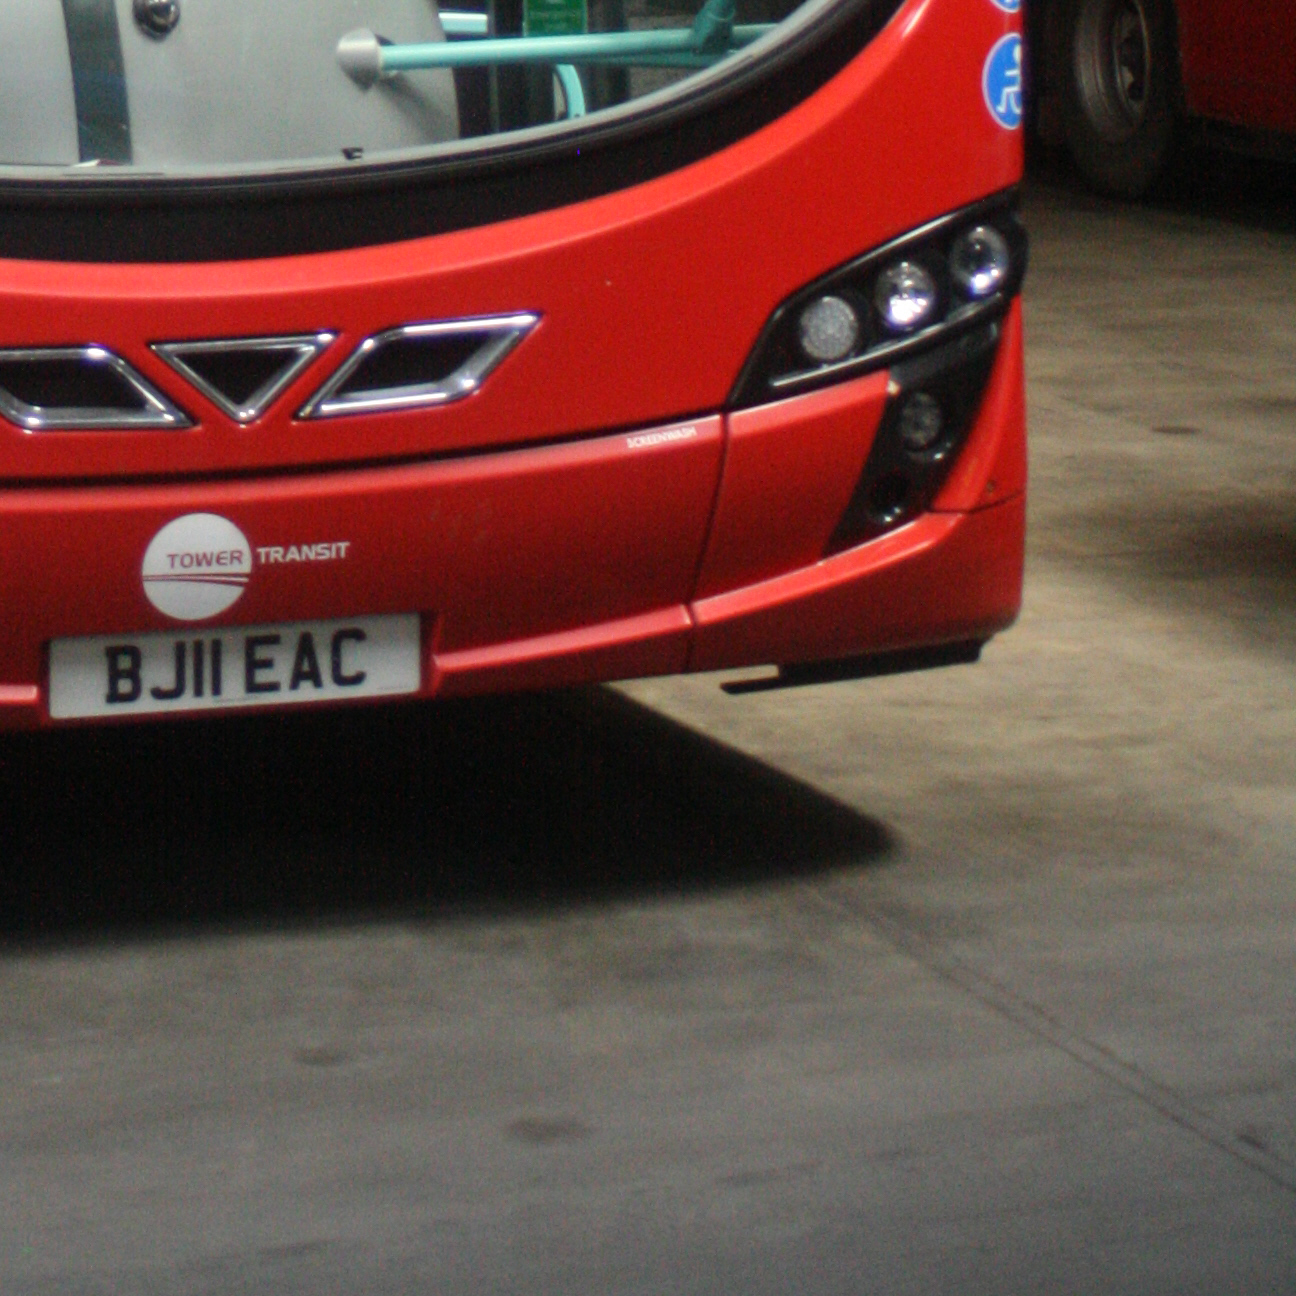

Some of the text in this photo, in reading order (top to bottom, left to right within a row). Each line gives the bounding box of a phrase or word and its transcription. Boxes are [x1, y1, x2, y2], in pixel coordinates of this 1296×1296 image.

[166, 541, 351, 569] TOWER TRANSIT
[106, 627, 368, 704] BJ11 EAC
